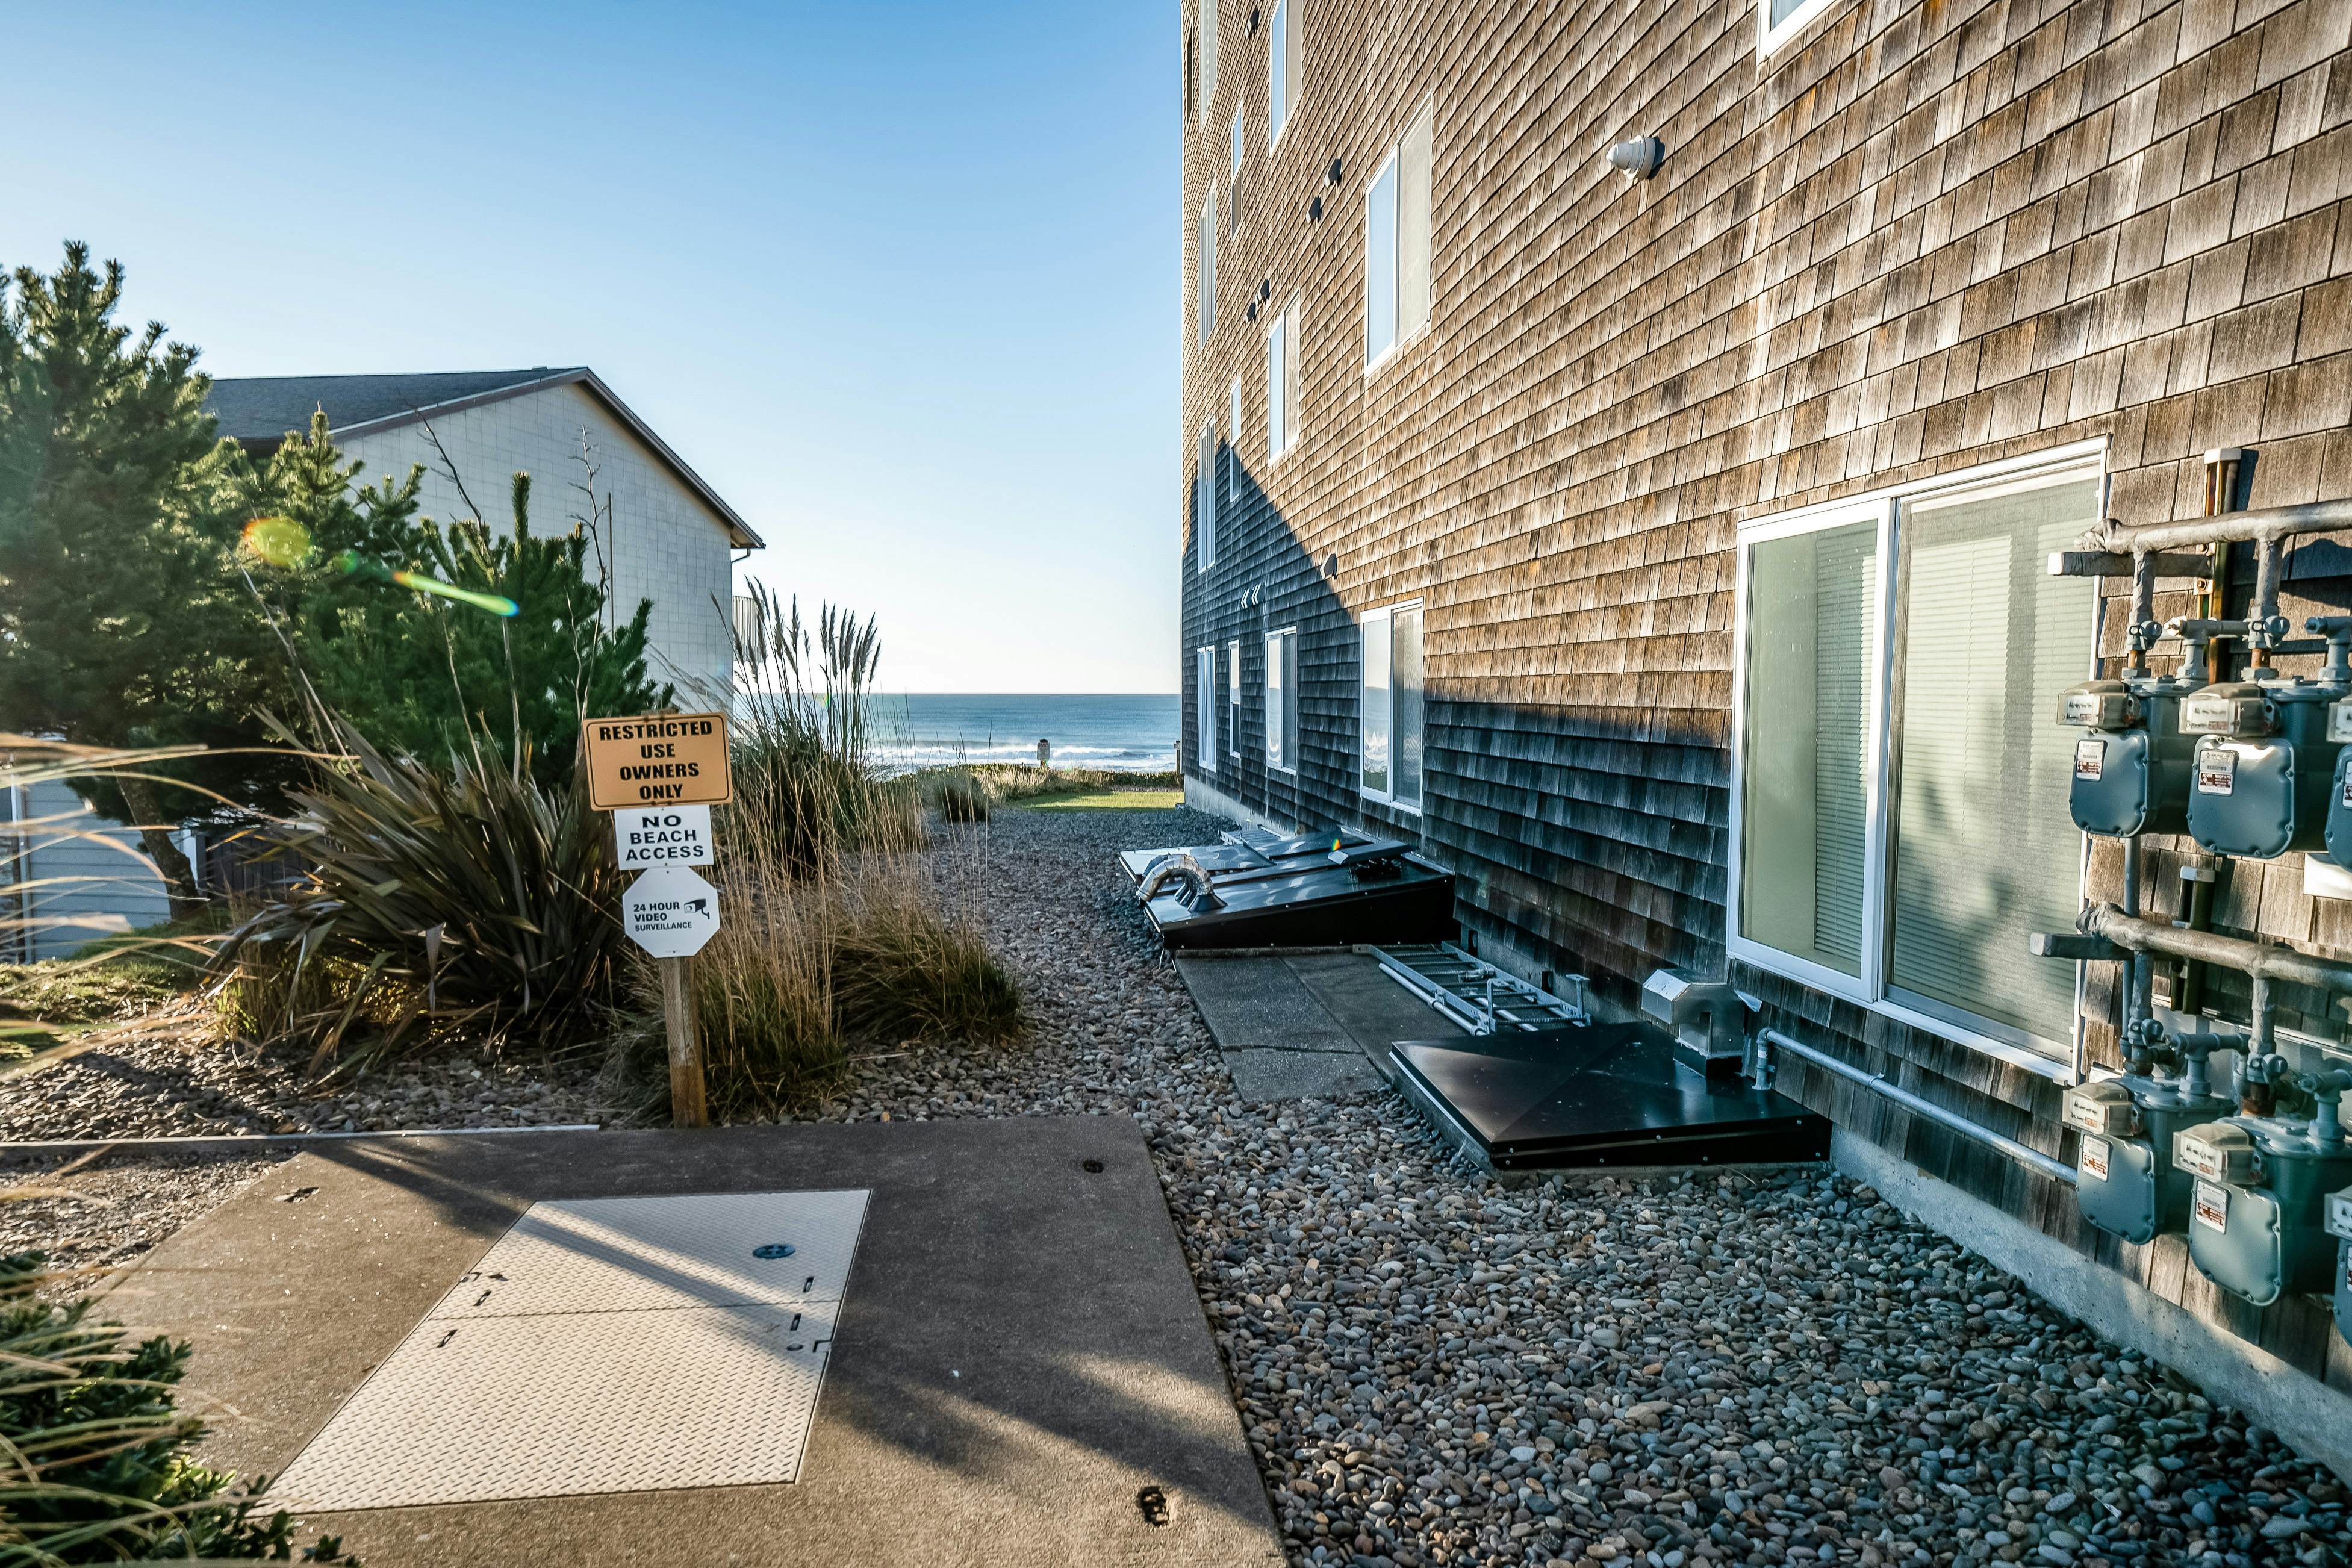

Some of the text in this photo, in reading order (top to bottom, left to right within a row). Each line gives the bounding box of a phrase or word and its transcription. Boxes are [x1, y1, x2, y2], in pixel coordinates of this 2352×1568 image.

[599, 721, 712, 741] RESTRICTED
[640, 743, 676, 759] USE
[620, 762, 700, 781] OWNERS
[639, 783, 683, 800] ONLY
[642, 815, 682, 829] NO
[630, 829, 697, 844] BEACH
[626, 845, 704, 862] ACCESS
[633, 901, 680, 912] 24 HOUR
[634, 912, 667, 922] VIDEO
[635, 921, 692, 932] SURVEILLANCE
